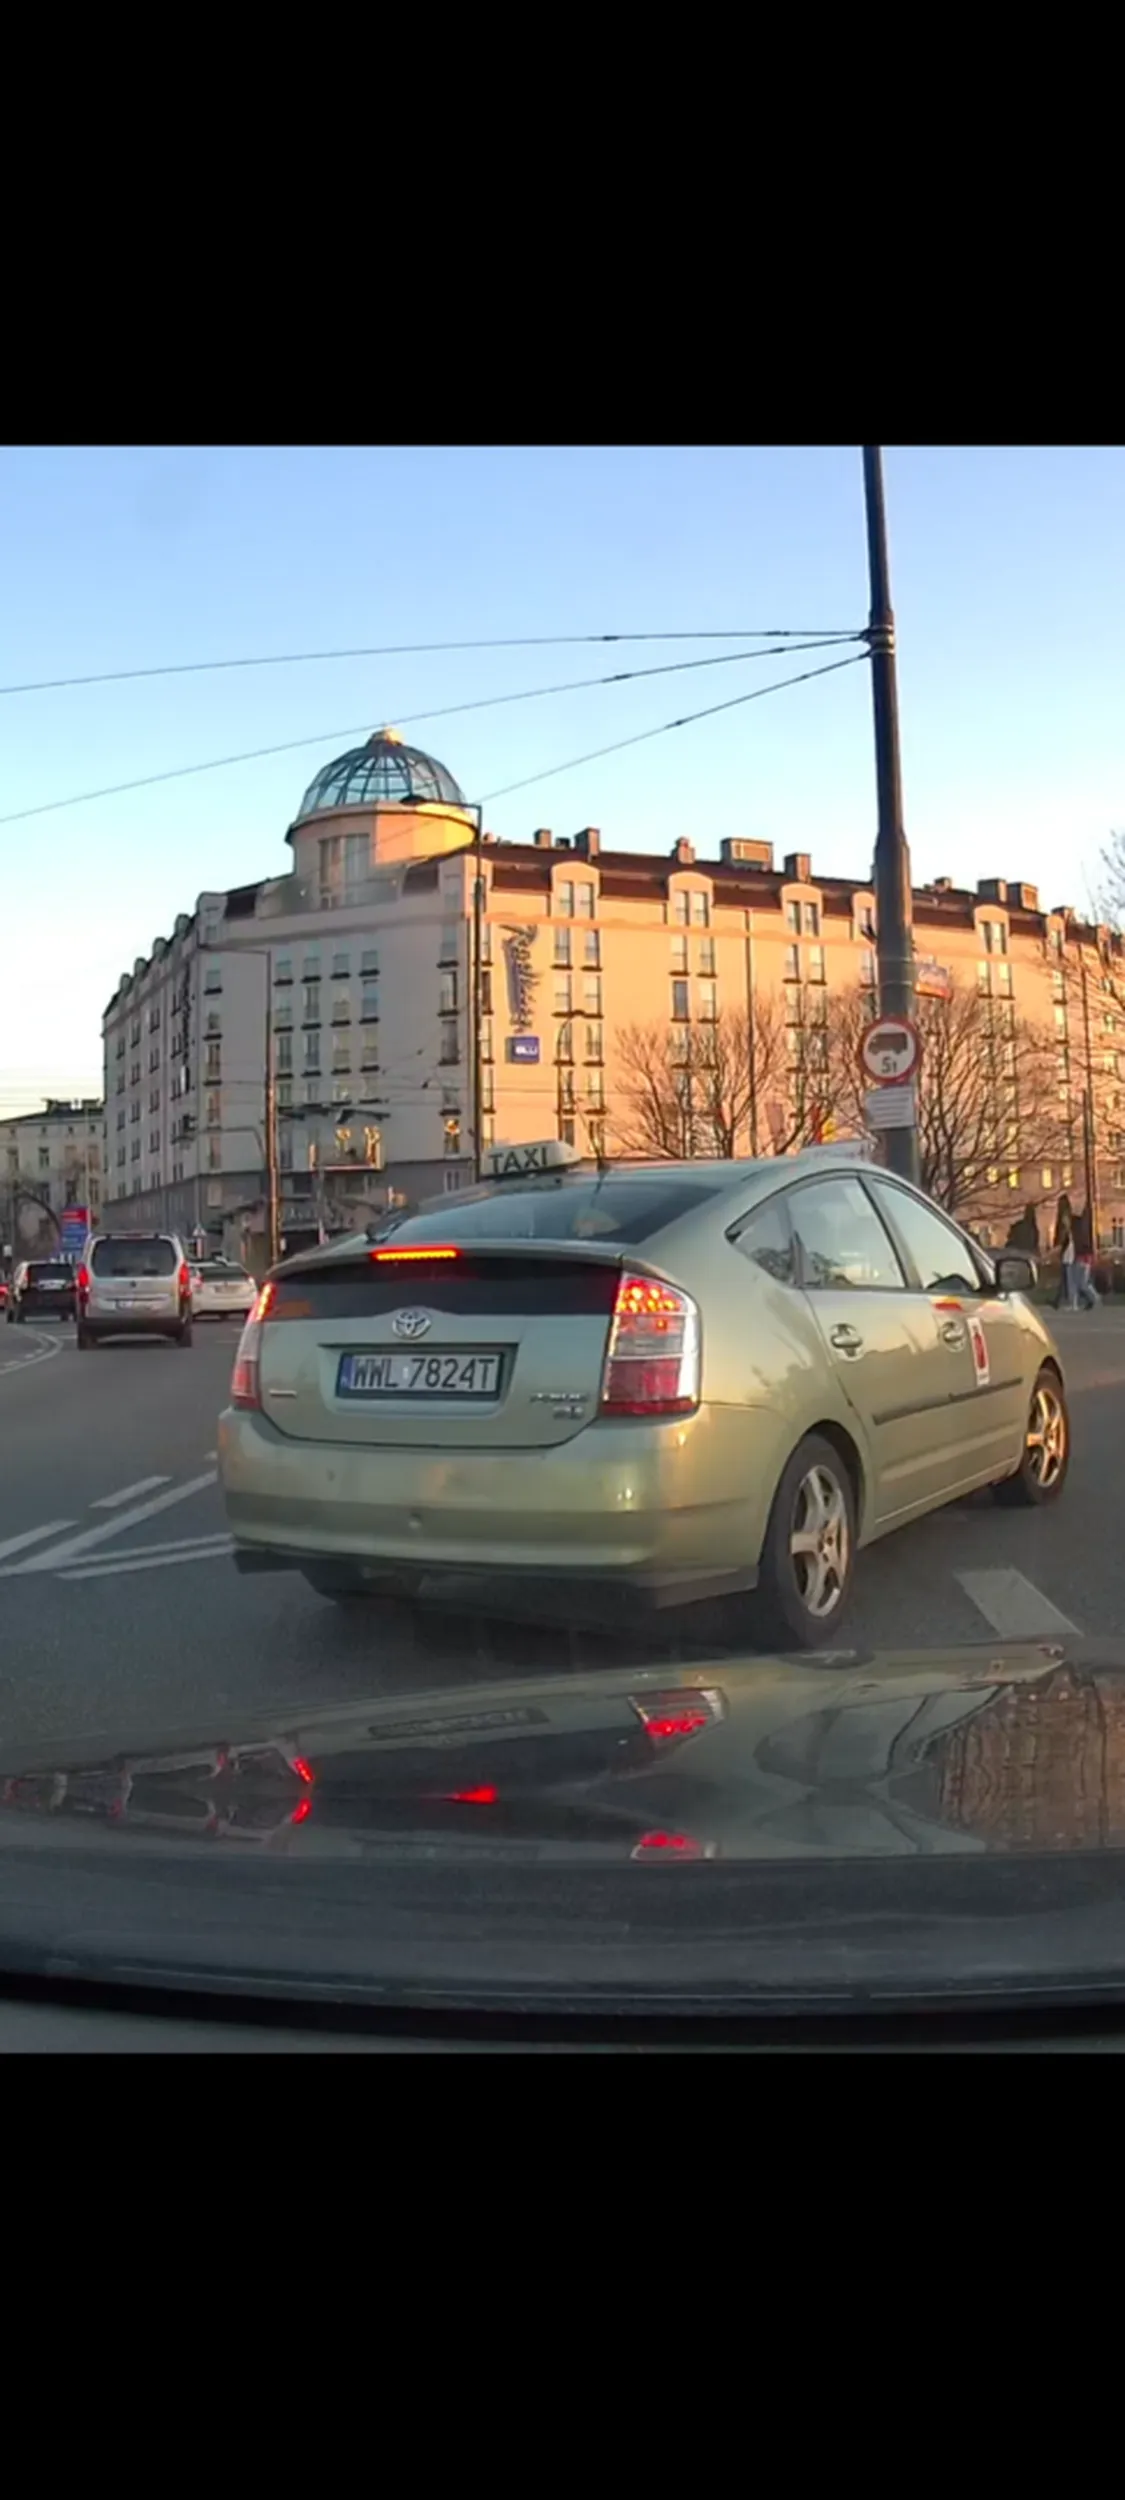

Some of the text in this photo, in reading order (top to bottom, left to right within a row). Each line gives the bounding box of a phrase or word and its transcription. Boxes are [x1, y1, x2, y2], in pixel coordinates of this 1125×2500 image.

[488, 1147, 548, 1174] TAXI
[353, 1357, 496, 1389] WWL 7824T
